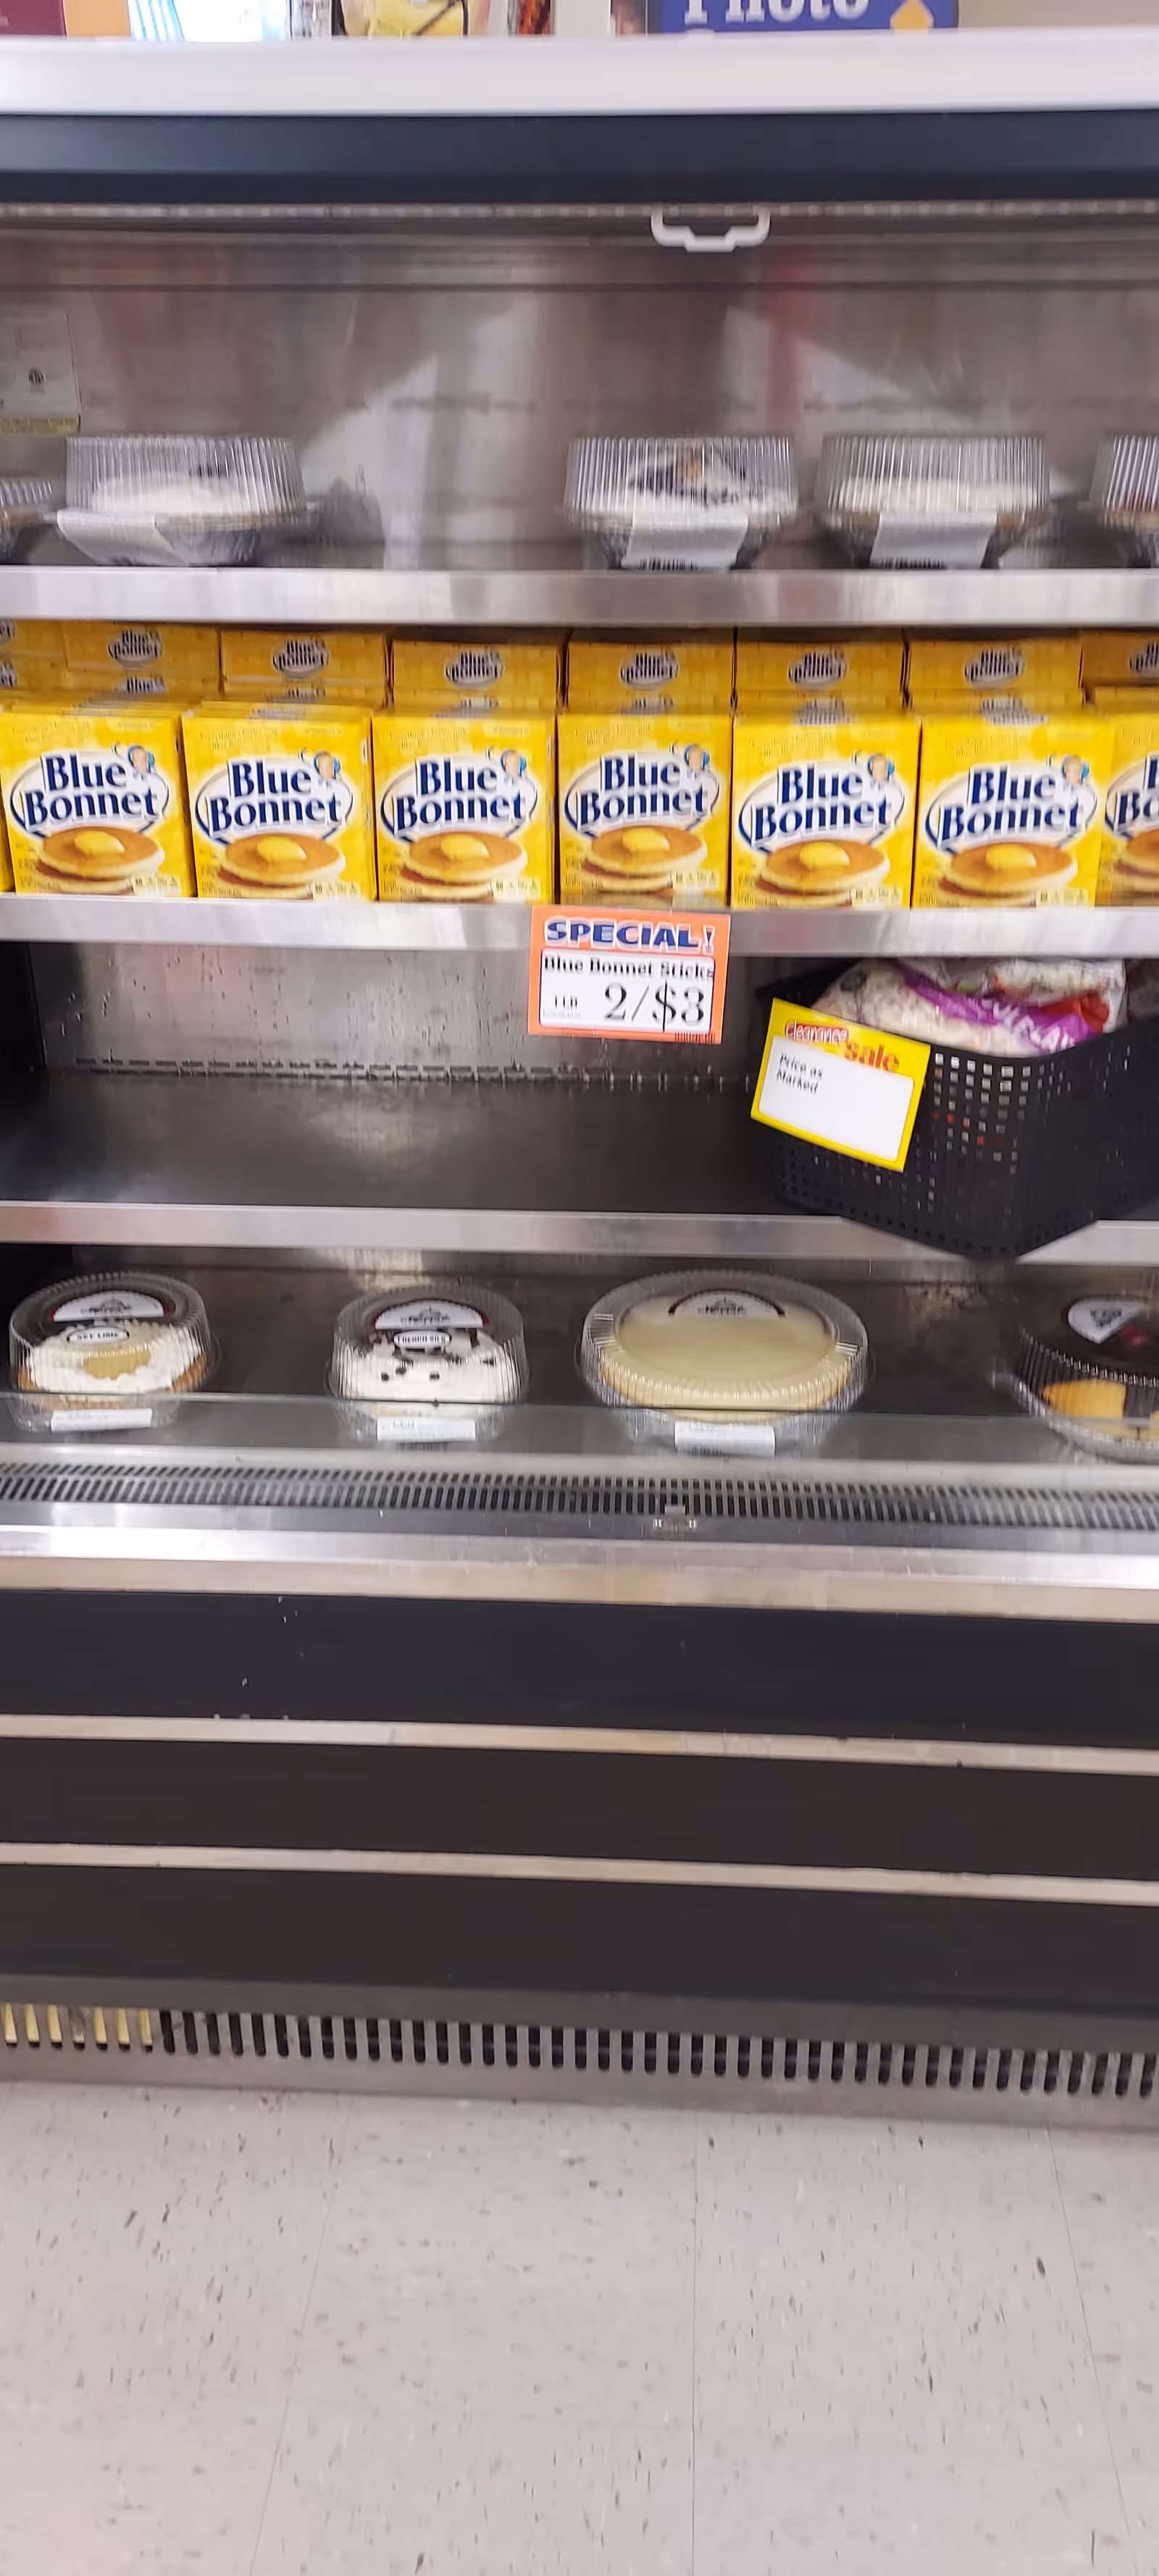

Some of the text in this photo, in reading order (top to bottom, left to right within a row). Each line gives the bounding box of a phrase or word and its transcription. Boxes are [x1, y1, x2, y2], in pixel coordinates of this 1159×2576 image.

[45, 755, 126, 791] Blue
[232, 762, 311, 798] Blue
[419, 761, 498, 795] Blue
[603, 757, 680, 791] Blue
[781, 768, 863, 804] Blue
[971, 766, 1056, 804] Blue
[25, 787, 157, 827] Bonnet
[210, 795, 342, 834] Bonnet
[396, 792, 522, 832] Bonnet
[580, 788, 705, 827] Bonnet
[755, 798, 890, 841] Bonnet
[942, 798, 1081, 842] Bonnet
[546, 917, 714, 953] SPECIAL!
[543, 956, 714, 979] Blue Bonnet Sticks
[604, 980, 705, 1032] 2/$3
[779, 1053, 823, 1079] Price as
[844, 1043, 900, 1072] sale
[777, 1069, 819, 1095] Marked
